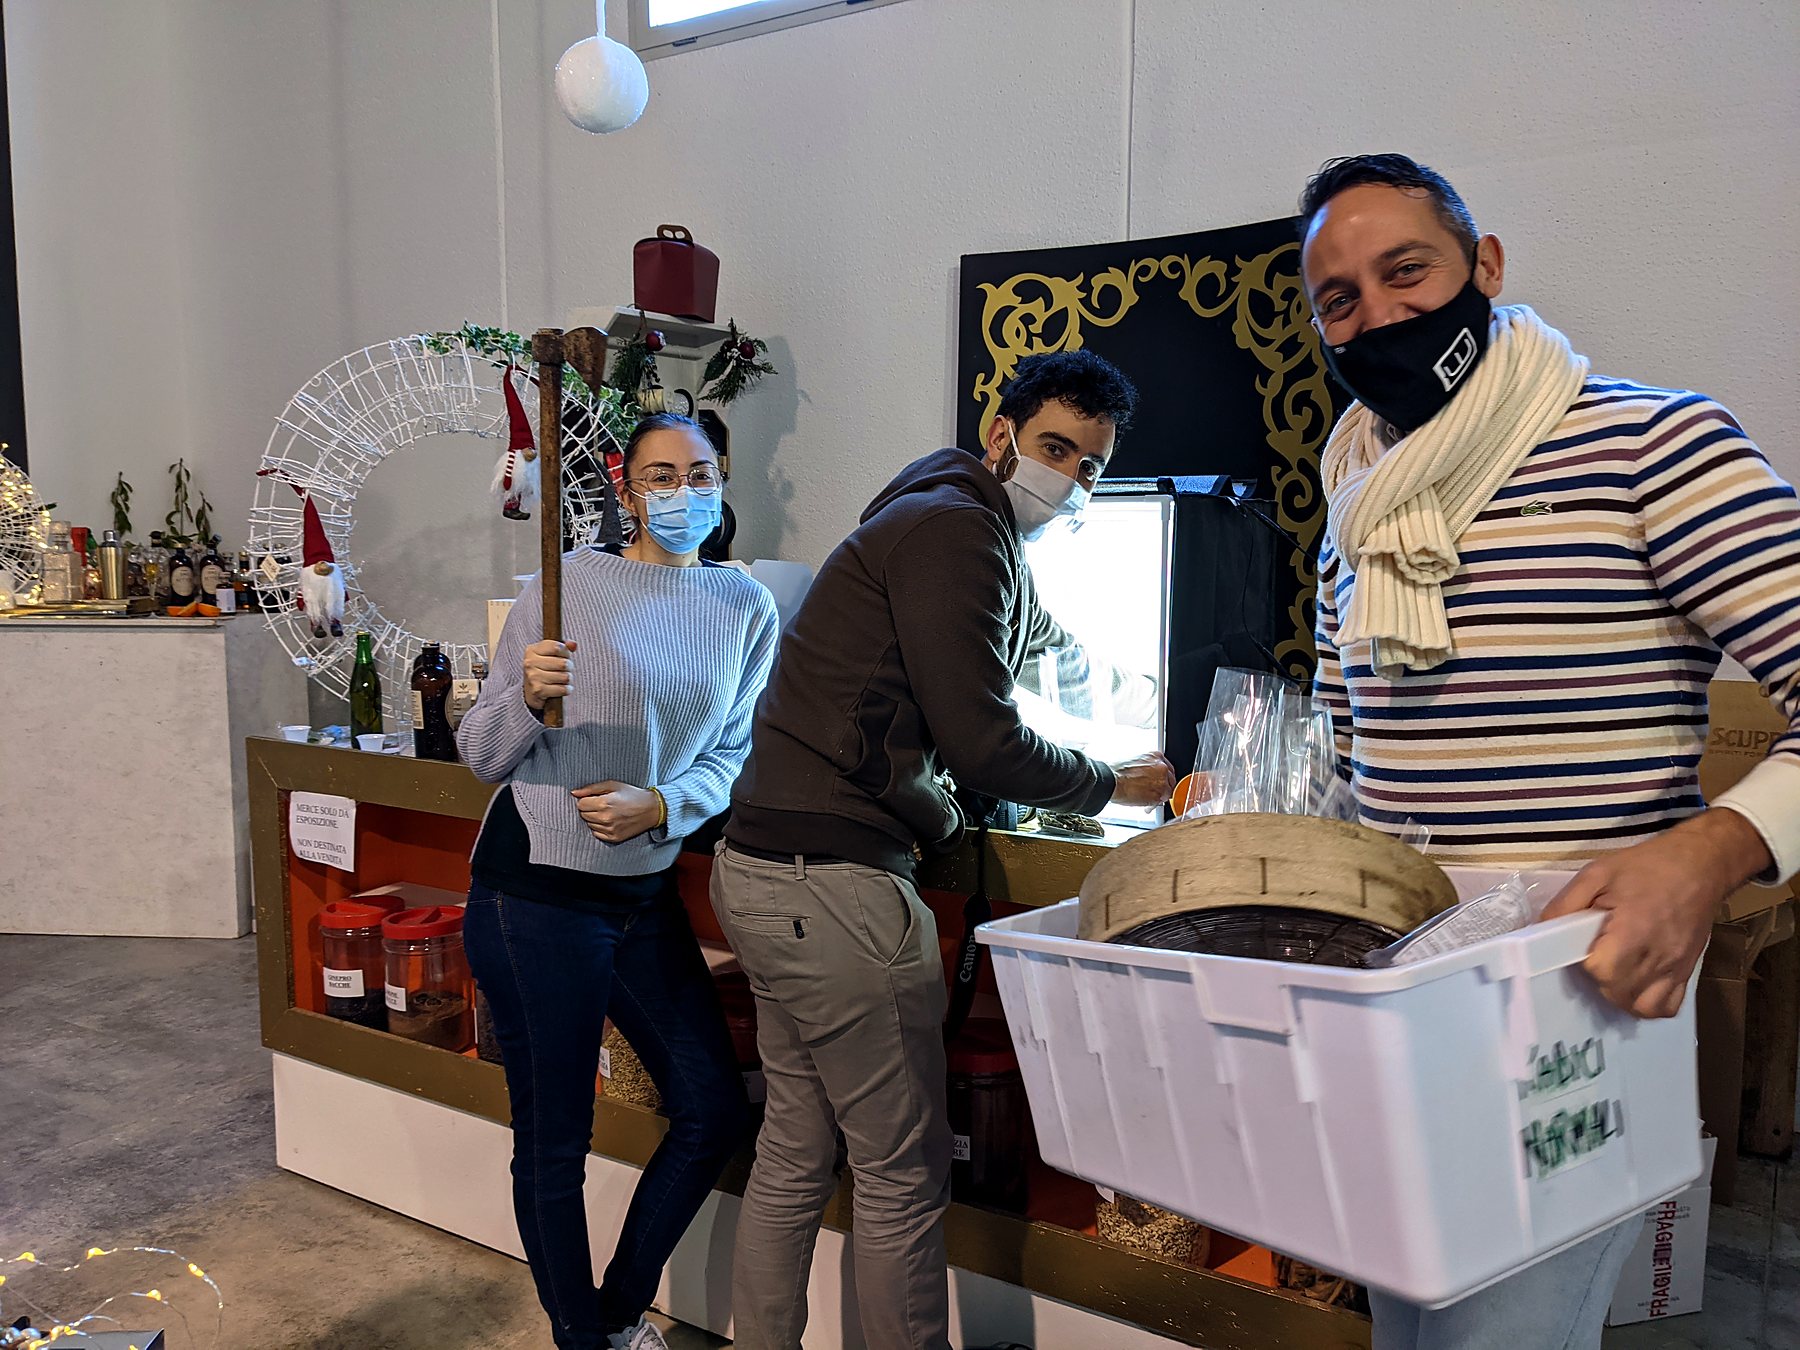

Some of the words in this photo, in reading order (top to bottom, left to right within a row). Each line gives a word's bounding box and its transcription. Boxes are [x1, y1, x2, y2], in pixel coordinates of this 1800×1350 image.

[296, 803, 320, 814] MERCE
[320, 806, 338, 816] SOLO
[338, 808, 349, 818] DA
[297, 838, 312, 847] NON
[313, 840, 347, 854] DESTINATA
[299, 850, 316, 860] ALLA
[316, 852, 343, 865] VENDITA
[960, 934, 977, 983] Canon
[953, 1139, 969, 1149] ZIA
